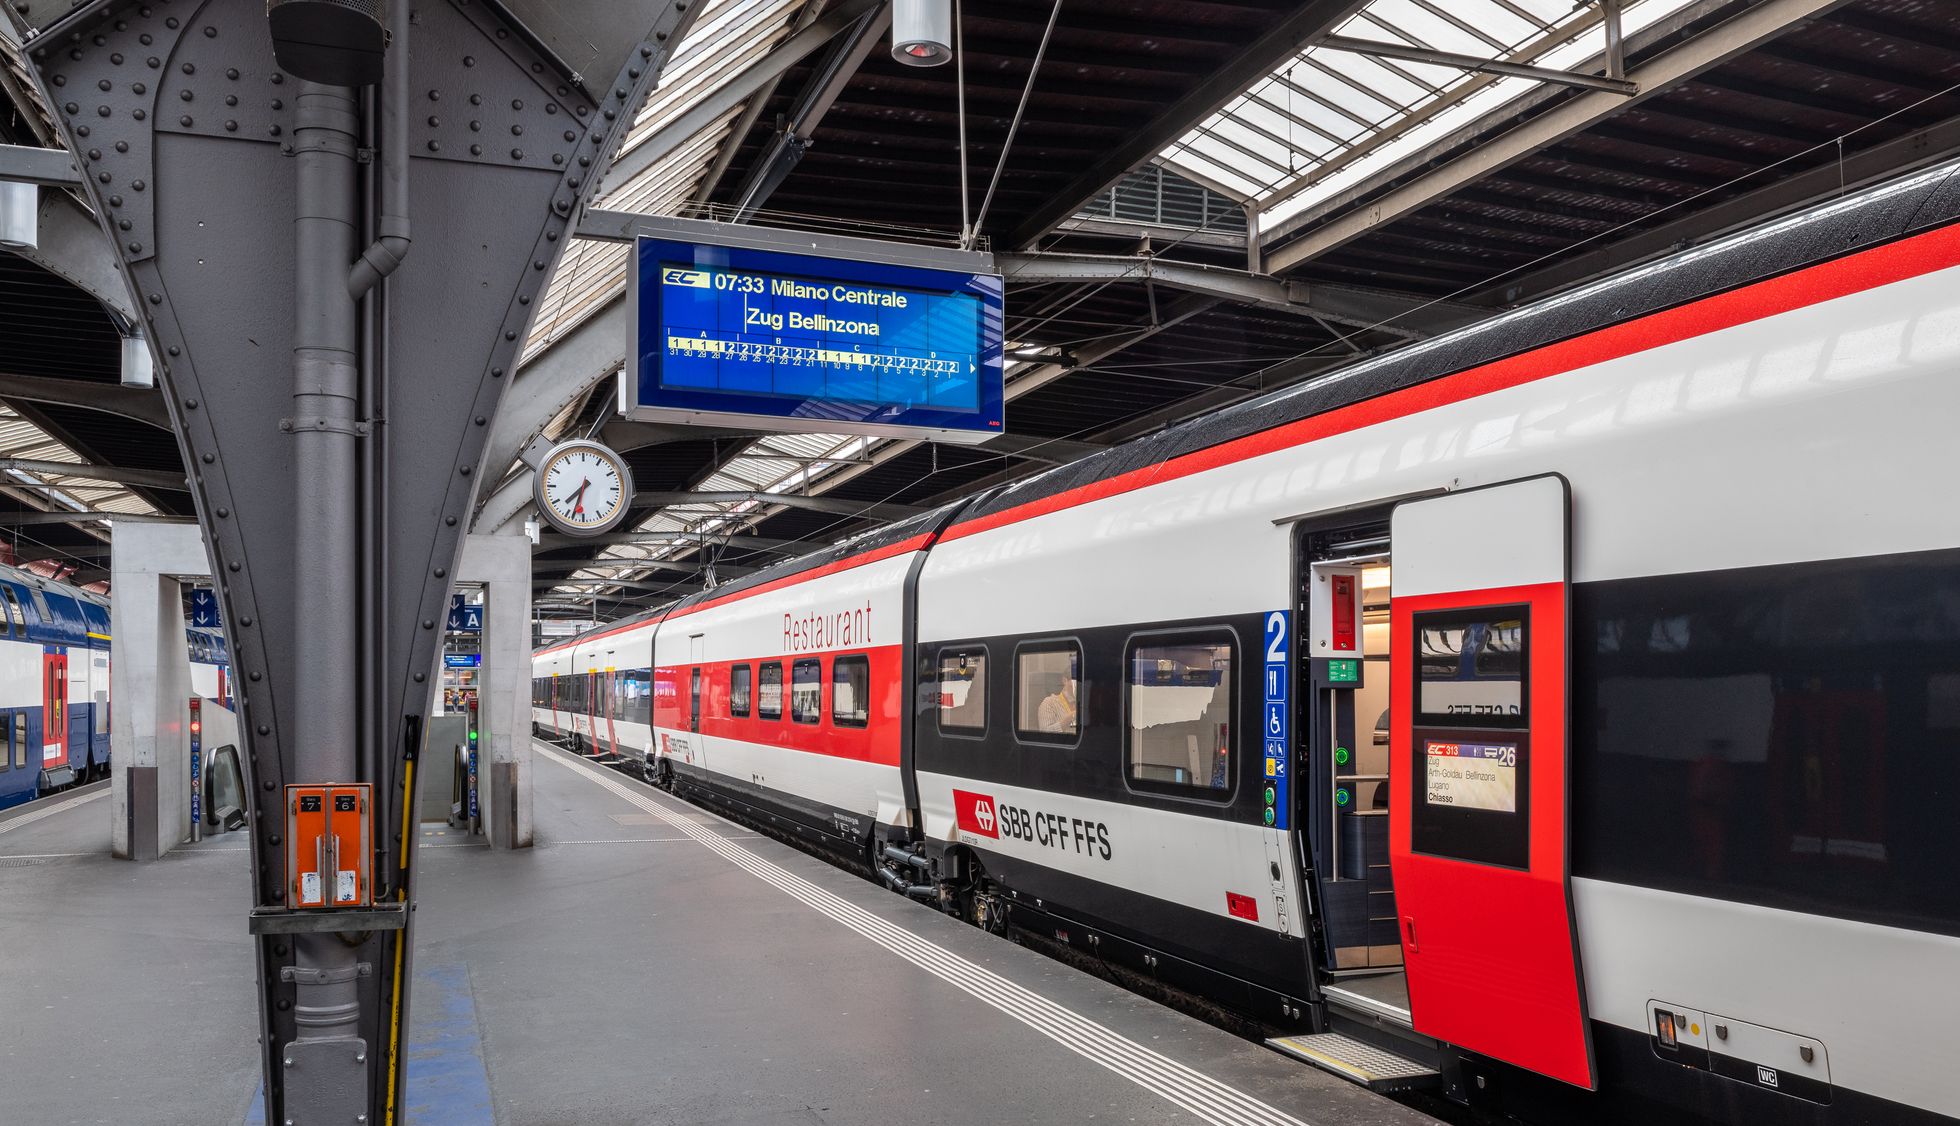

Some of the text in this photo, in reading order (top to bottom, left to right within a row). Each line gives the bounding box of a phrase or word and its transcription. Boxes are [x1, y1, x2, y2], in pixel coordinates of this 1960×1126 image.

[665, 271, 908, 308] EC 07:33 Milano Centrale
[747, 307, 880, 336] Zug Bellinzona
[670, 348, 679, 356] 31
[684, 348, 692, 357] 30
[725, 352, 734, 360] 27
[753, 354, 761, 362] 25
[766, 355, 775, 363] 24
[780, 356, 788, 365] 23
[793, 357, 801, 366] 22
[806, 358, 814, 367] 21
[821, 360, 827, 368] 11
[834, 361, 840, 369] 10
[728, 343, 735, 352] 2
[742, 344, 748, 353] 2
[755, 345, 762, 354] 2
[769, 346, 776, 356] 2
[782, 348, 789, 357] 2
[796, 349, 802, 358] 2
[809, 350, 815, 359] 2
[874, 356, 880, 365] 2
[887, 357, 893, 366] 2
[900, 358, 905, 368] 2
[912, 359, 918, 368] 2
[925, 360, 930, 370] 2
[937, 361, 943, 371] 2
[949, 362, 955, 372] 2
[776, 337, 781, 345] B
[854, 344, 860, 352] C
[931, 351, 936, 359] D
[467, 613, 479, 627] A
[784, 600, 872, 651] Restaurant
[1266, 611, 1286, 662] 2
[1428, 745, 1516, 766] EC 313 26
[1429, 757, 1439, 767] Zug
[1428, 768, 1496, 781] Arth-Goldau Bellinzona
[1429, 781, 1450, 791] Lugano
[307, 802, 315, 810] 7
[341, 802, 350, 810] 6
[1428, 792, 1453, 803] Chiasso
[1000, 804, 1112, 861] SBB CFF FFS
[1760, 1070, 1775, 1083] WC
